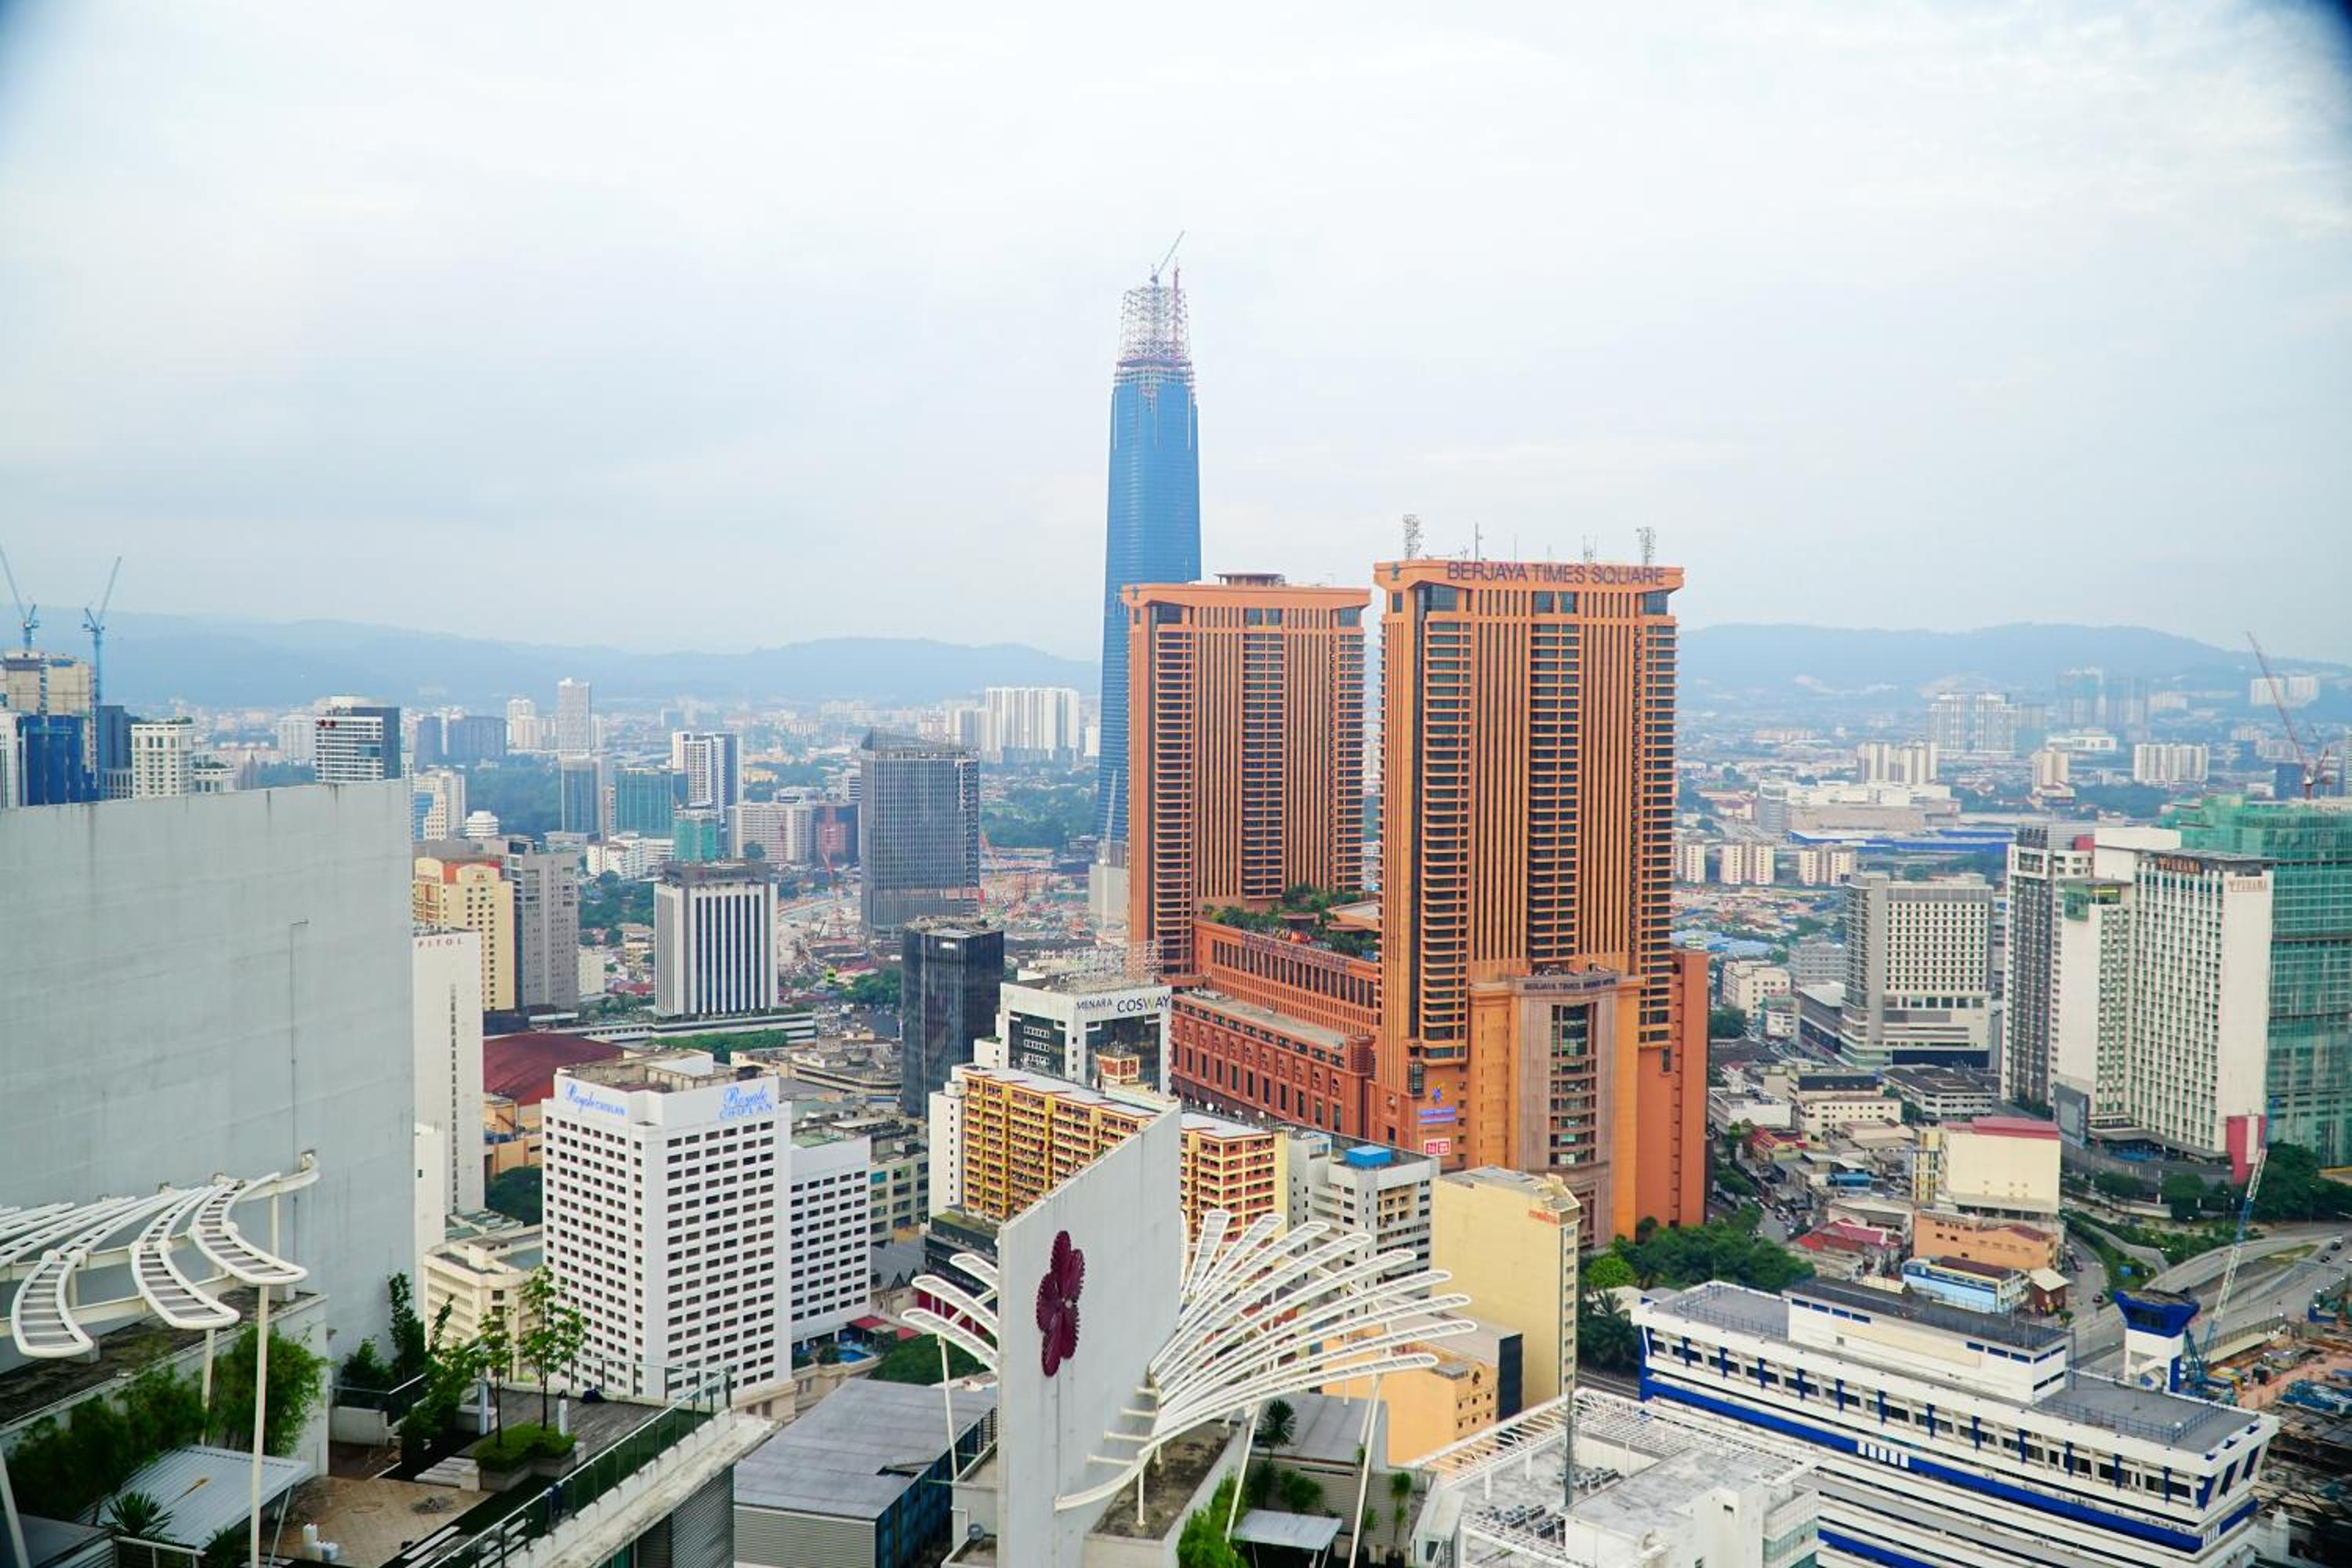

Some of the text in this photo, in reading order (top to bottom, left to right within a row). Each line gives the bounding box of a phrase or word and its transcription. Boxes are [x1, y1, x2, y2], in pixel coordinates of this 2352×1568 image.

[1447, 561, 1664, 585] BERJAYA TIMES SQUARE
[1076, 995, 1171, 1013] MENARA COSWAY
